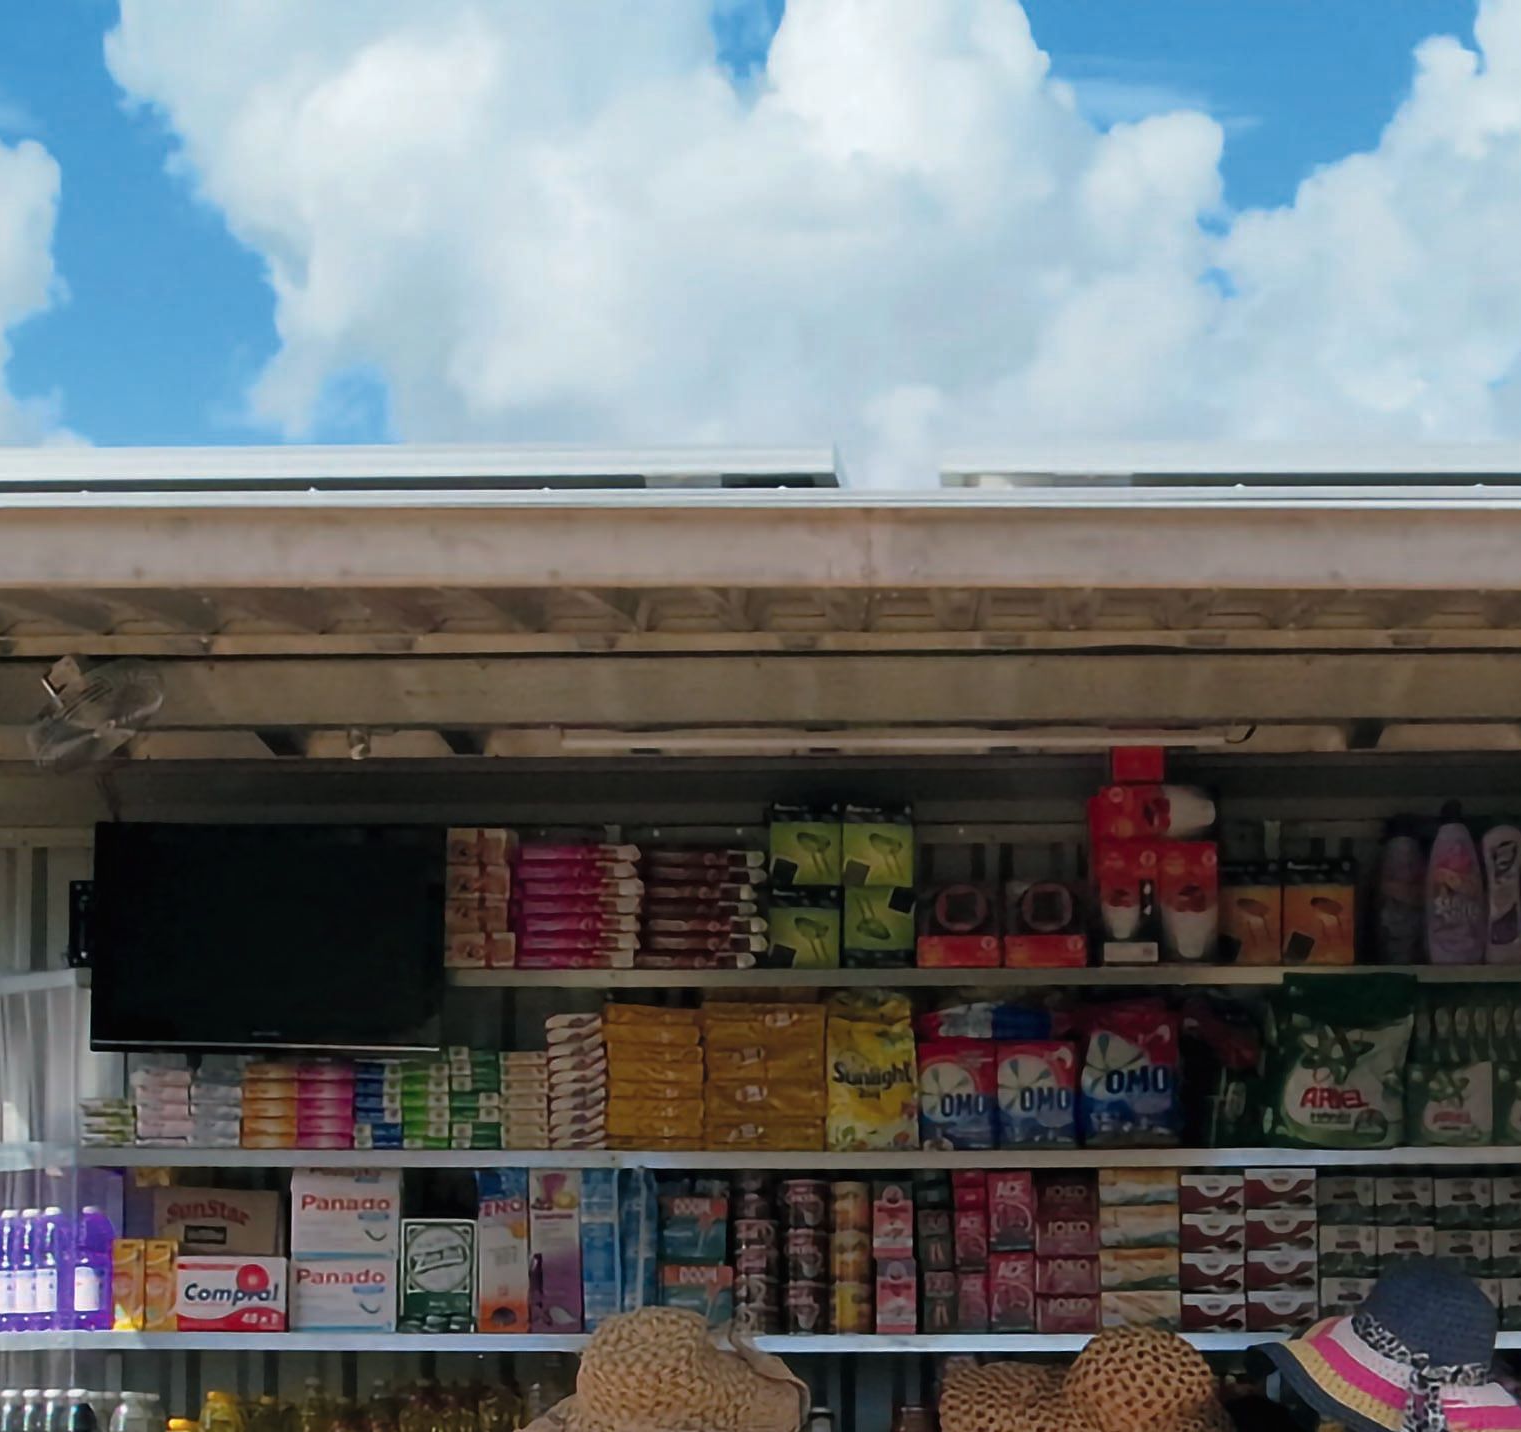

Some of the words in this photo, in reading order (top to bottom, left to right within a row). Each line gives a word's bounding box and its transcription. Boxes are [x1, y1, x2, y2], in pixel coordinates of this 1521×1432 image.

[832, 1060, 912, 1090] Sunlight
[1104, 1065, 1167, 1095] OMO
[940, 1091, 986, 1116] OMO
[1020, 1086, 1070, 1112] OMO
[301, 1194, 390, 1211] Panado
[482, 1199, 524, 1217] ENO
[1044, 1220, 1091, 1238] JOKO
[296, 1268, 385, 1285] Panado
[184, 1282, 278, 1307] Compral
